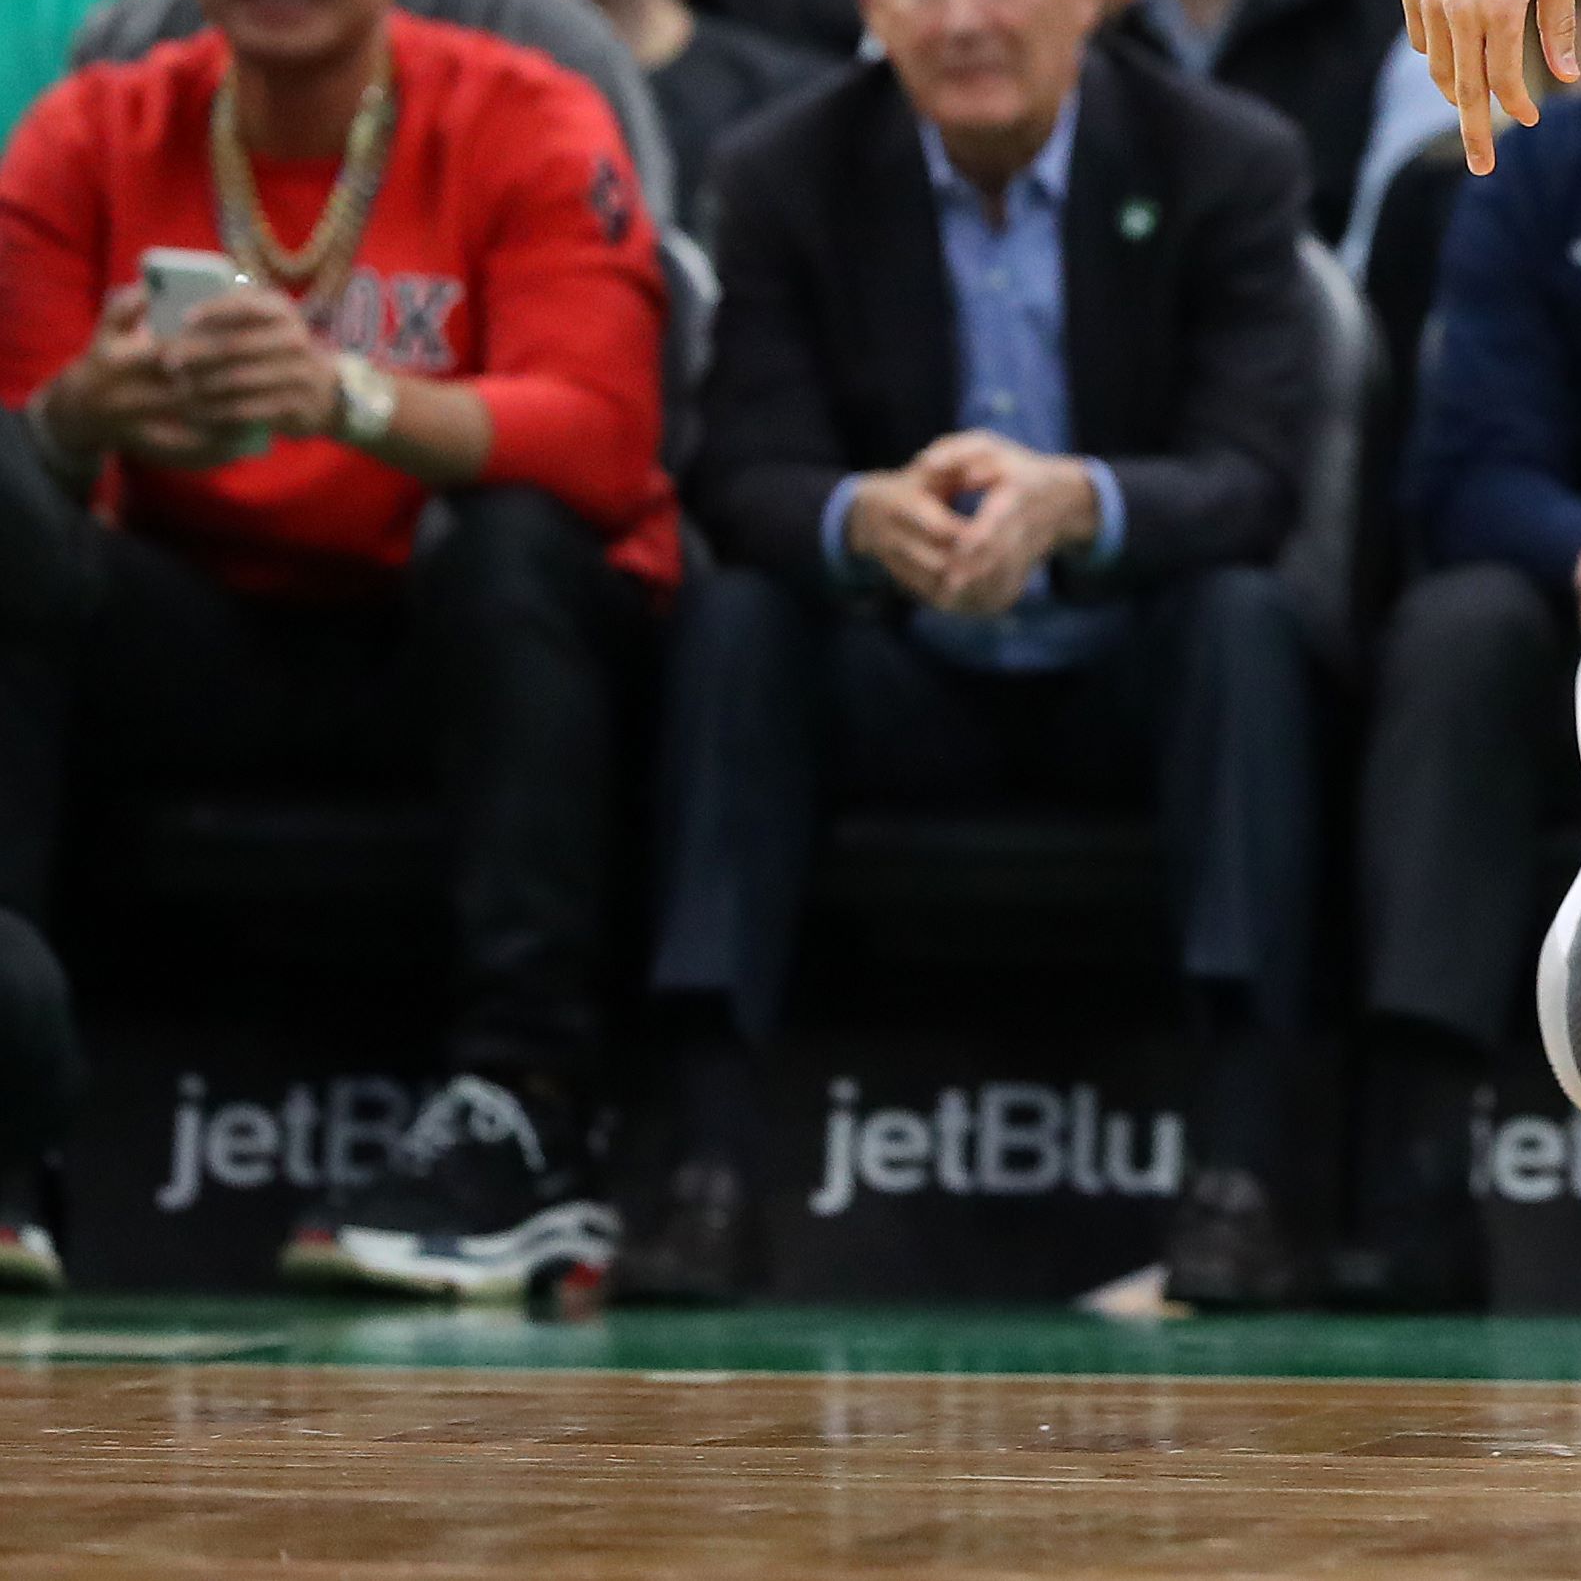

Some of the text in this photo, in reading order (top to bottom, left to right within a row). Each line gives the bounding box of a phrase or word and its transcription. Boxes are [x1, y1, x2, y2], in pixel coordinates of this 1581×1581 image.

[342, 267, 466, 367] OX
[155, 1072, 412, 1209] jetB
[808, 1076, 1186, 1217] jetBlu
